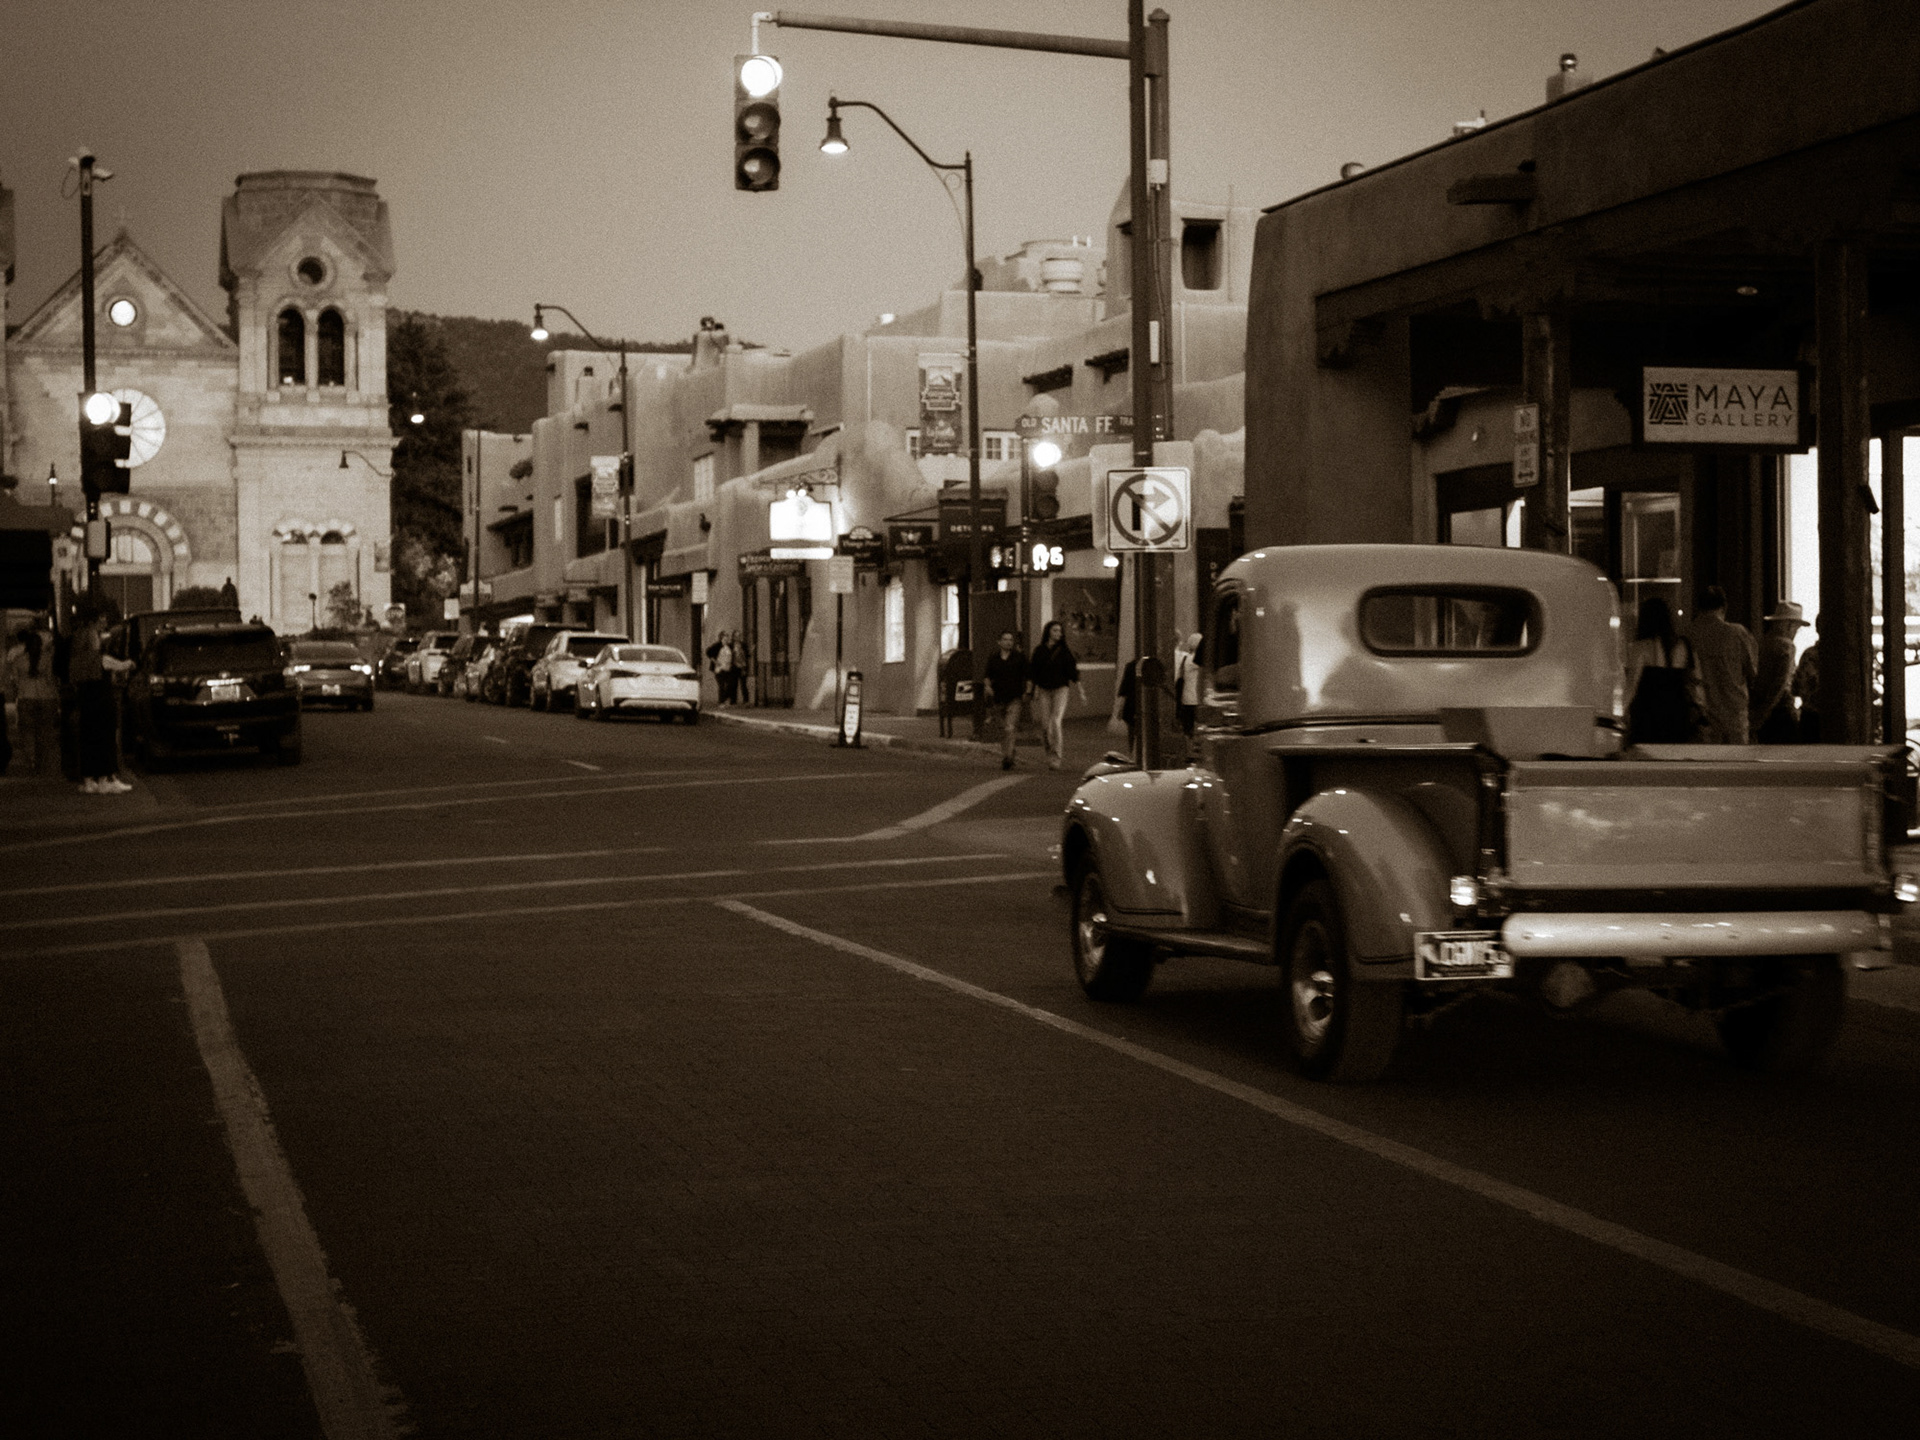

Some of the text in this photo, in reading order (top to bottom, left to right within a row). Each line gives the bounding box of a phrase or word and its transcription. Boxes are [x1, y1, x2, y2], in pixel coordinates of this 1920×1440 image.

[1695, 384, 1792, 410] MAYA
[1021, 418, 1037, 428] OLD
[1041, 416, 1089, 434] SANTA
[1695, 413, 1793, 427] GALLERY
